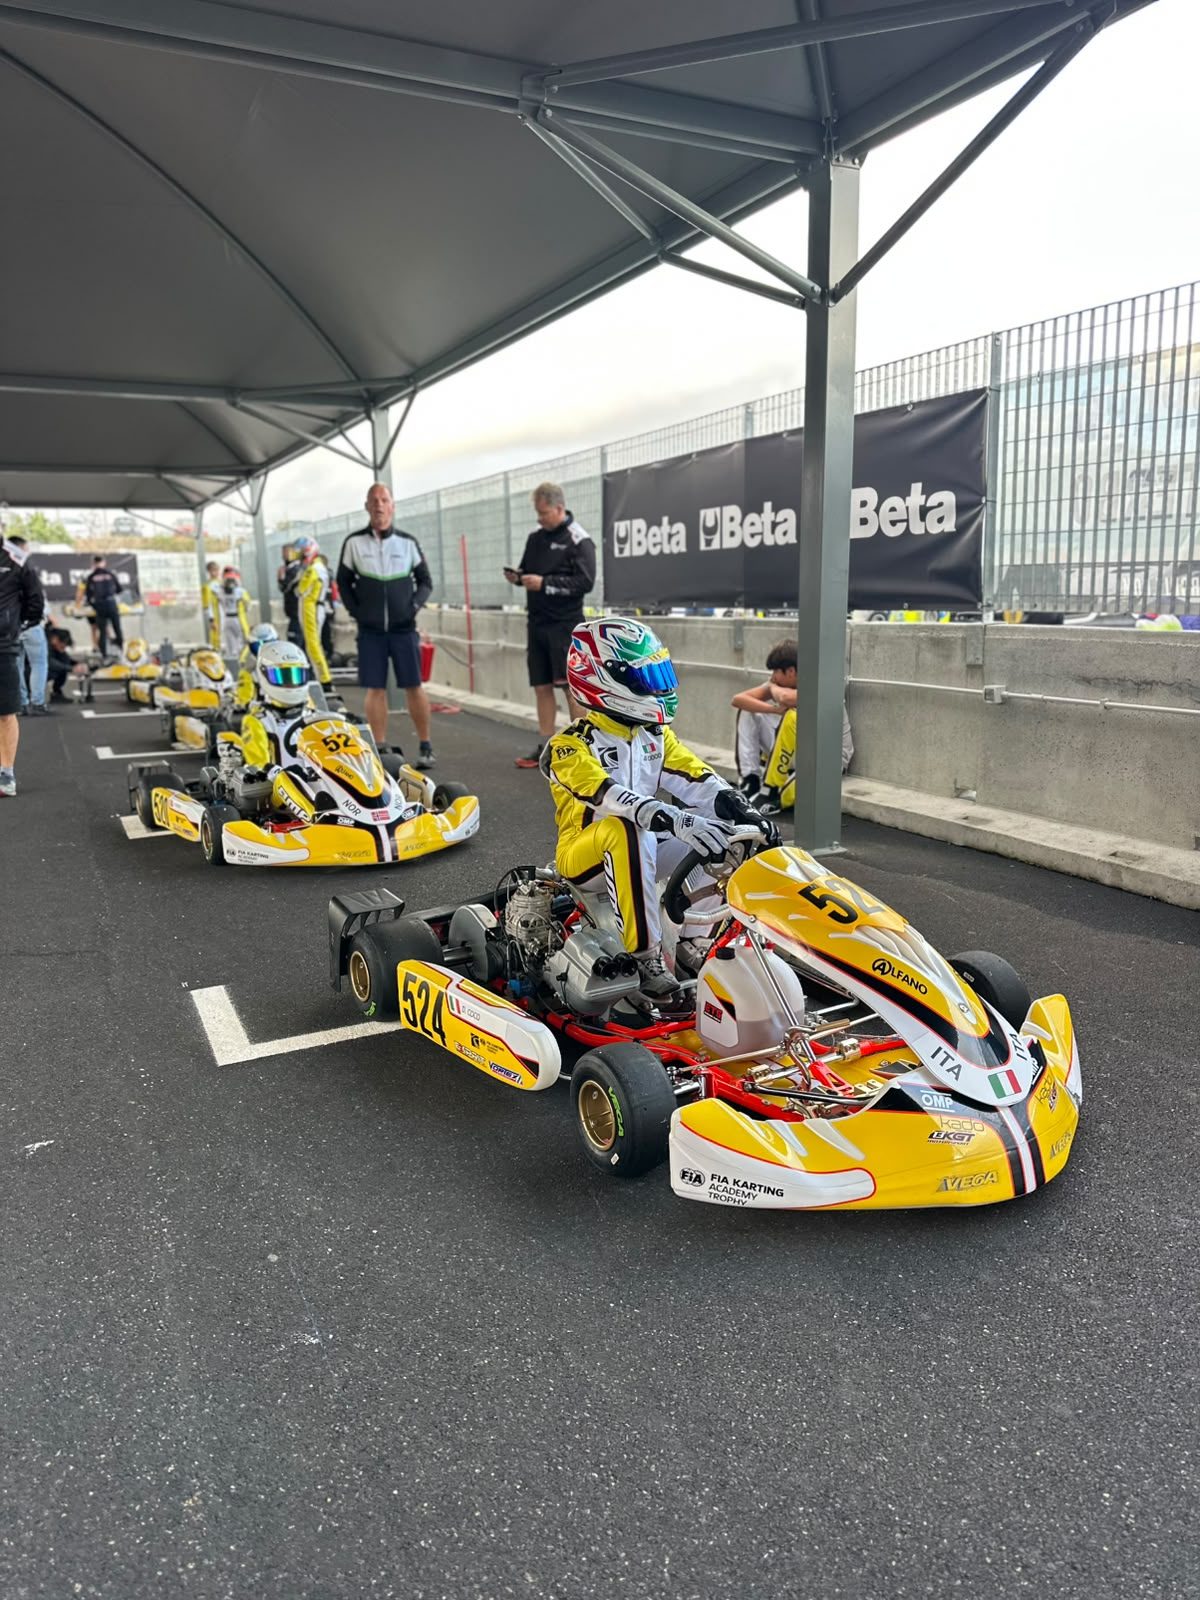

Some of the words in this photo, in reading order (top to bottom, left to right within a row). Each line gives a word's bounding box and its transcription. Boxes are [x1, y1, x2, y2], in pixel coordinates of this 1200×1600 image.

[850, 482, 956, 540] Beta
[631, 516, 687, 556] Beta
[722, 501, 797, 549] Beta
[777, 748, 795, 775] COL
[342, 799, 361, 816] NOR
[616, 790, 640, 807] ITA
[872, 958, 928, 995] ALFANO
[402, 971, 448, 1048] 524
[1009, 1033, 1027, 1061] ITA
[930, 1046, 963, 1081] ITA
[609, 1086, 625, 1137] VEGA
[921, 1093, 954, 1109] OMP
[940, 1115, 985, 1132] kado
[708, 1183, 758, 1201] ACADEMY
[710, 1173, 729, 1185] FIA
[732, 1178, 784, 1197] KARTING
[939, 1170, 999, 1191] VEGA
[707, 1191, 748, 1206] TROPHY
